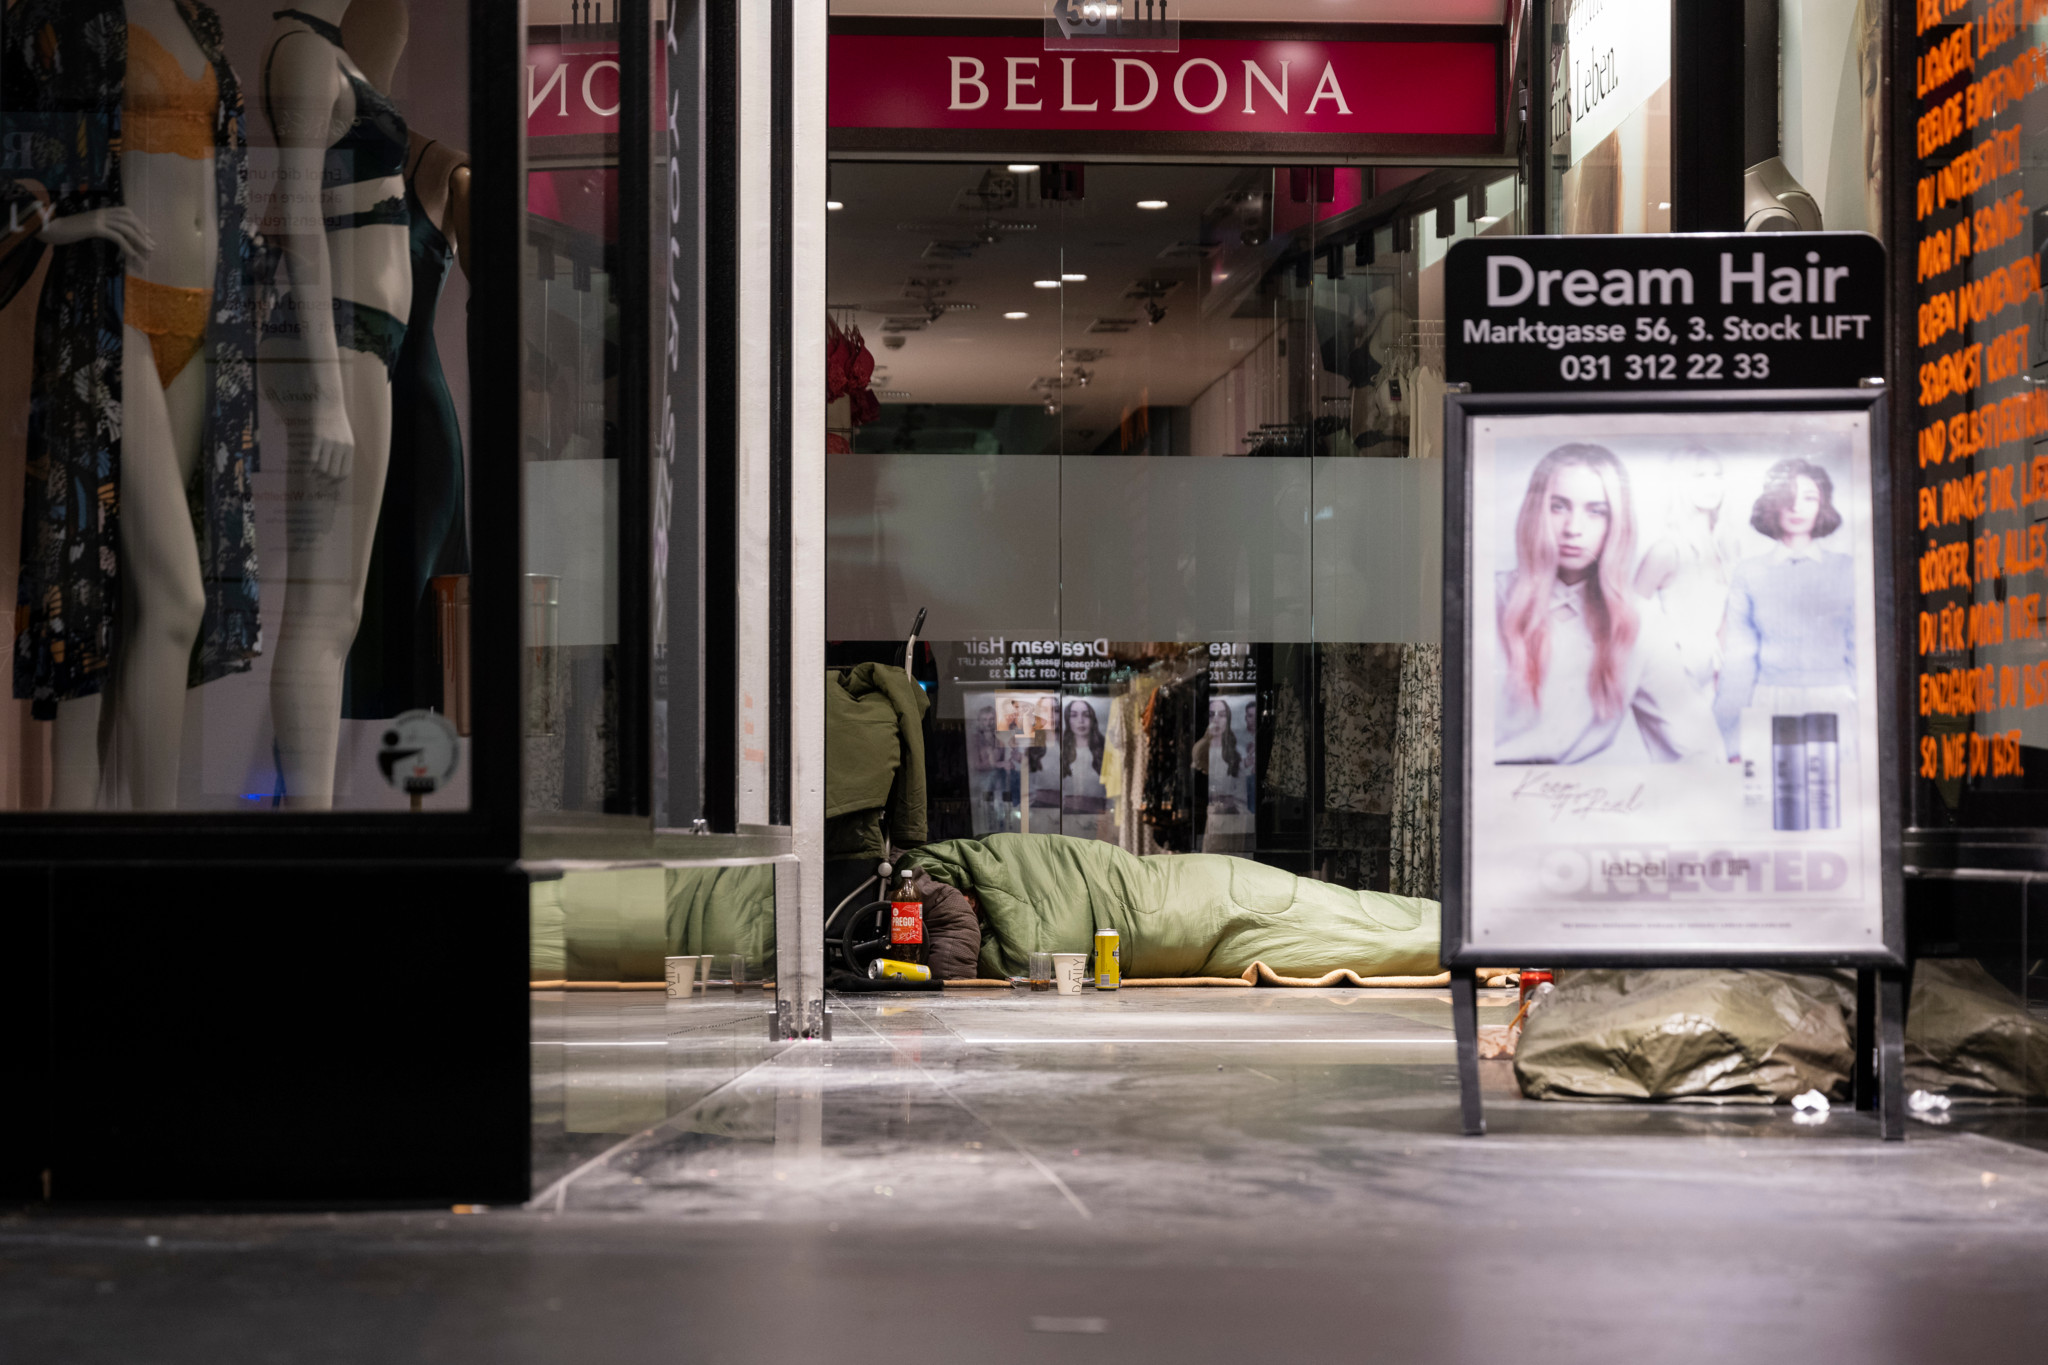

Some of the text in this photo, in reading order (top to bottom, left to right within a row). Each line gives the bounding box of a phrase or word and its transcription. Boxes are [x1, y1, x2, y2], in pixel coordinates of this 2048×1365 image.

[947, 56, 1353, 115] BELDONA
[1576, 45, 1619, 123] Leben.
[1917, 91, 1963, 159] FREUDE
[1917, 175, 1936, 222] DU
[667, 89, 680, 372] YOUR
[1917, 228, 1952, 284] MICH
[1954, 216, 1971, 265] IN
[1487, 250, 1849, 307] Dream Hair
[1463, 314, 1871, 350] Marktgasse 56, 3. Stock LIFT
[1918, 289, 1956, 348] RIGEN
[1560, 353, 1770, 381] 031 312 22 33
[1986, 323, 2030, 384] KRAFT
[1918, 419, 1947, 469] UND
[1942, 469, 1987, 525] DANKE
[1918, 539, 1973, 595] KÖRPER,
[1974, 529, 2001, 584] FÜR
[1919, 611, 1938, 656] DU
[1940, 601, 1965, 654] FÜR
[1967, 599, 2004, 650] MICH
[1227, 671, 1245, 681] 312
[1999, 664, 2019, 709] DU
[1919, 729, 2025, 782] SO WIE DU BIST.
[892, 916, 915, 927] PREGO!
[1071, 958, 1085, 993] DAILY
